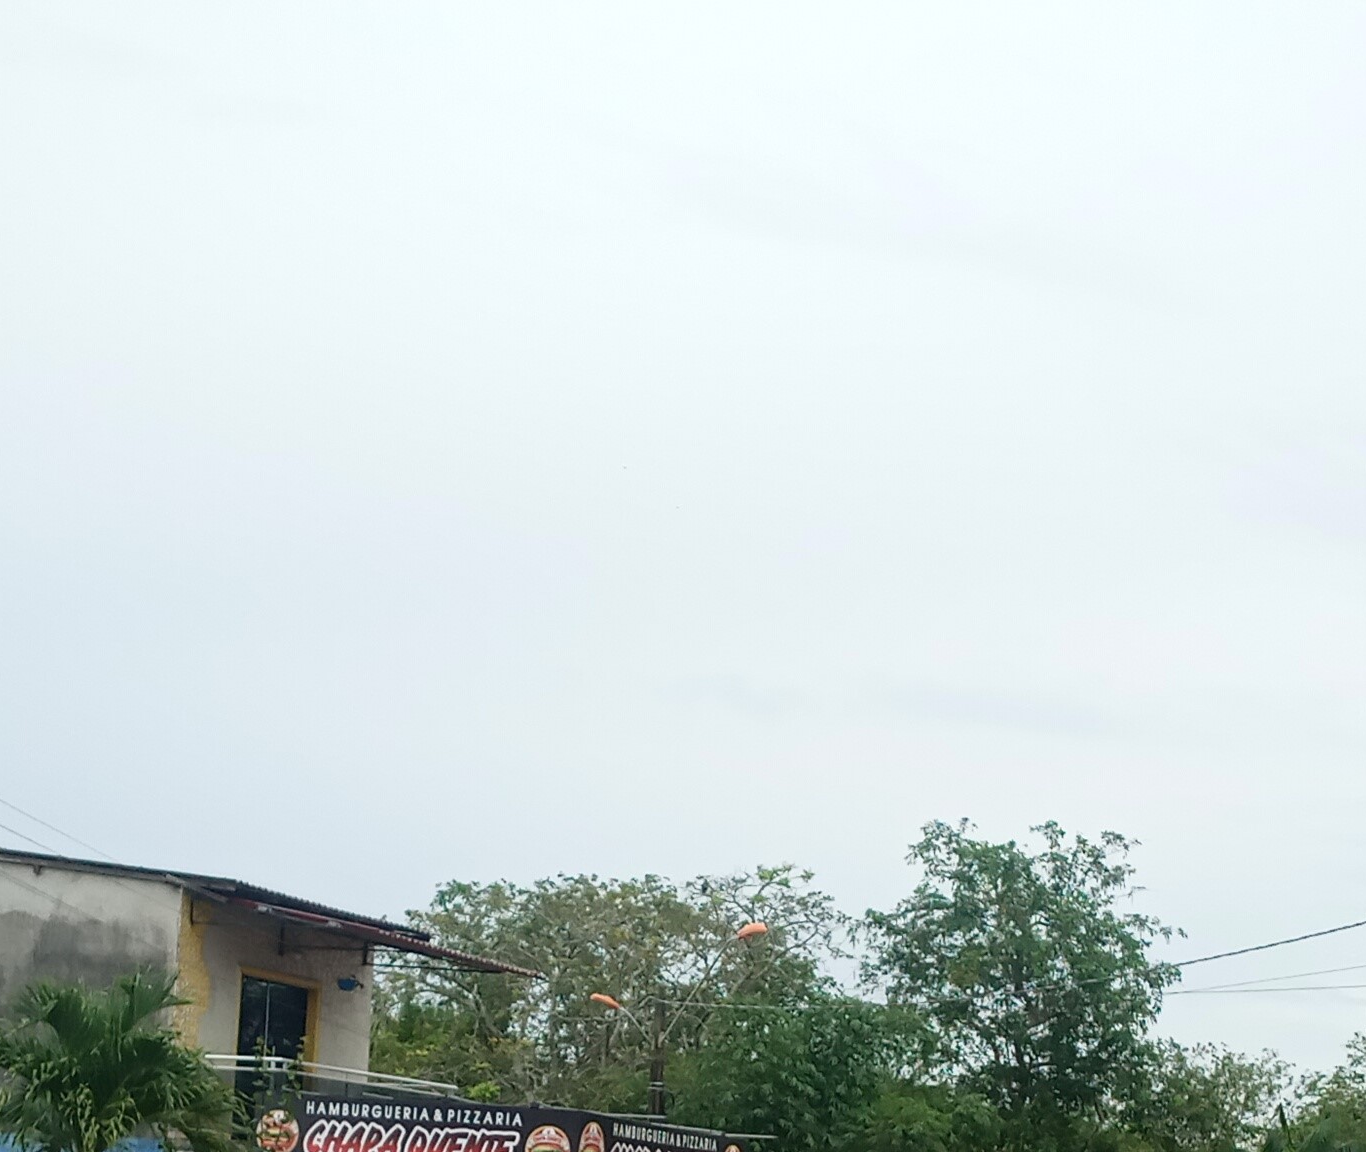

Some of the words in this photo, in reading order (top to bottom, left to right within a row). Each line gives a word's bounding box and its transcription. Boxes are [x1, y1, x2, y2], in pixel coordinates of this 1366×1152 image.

[306, 1100, 429, 1122] HAMBURGUERIA
[433, 1109, 444, 1123] &
[446, 1109, 524, 1128] PIZZARIA
[612, 1121, 675, 1145] HAMBURGUERIA
[682, 1134, 719, 1152] PIZZARIA
